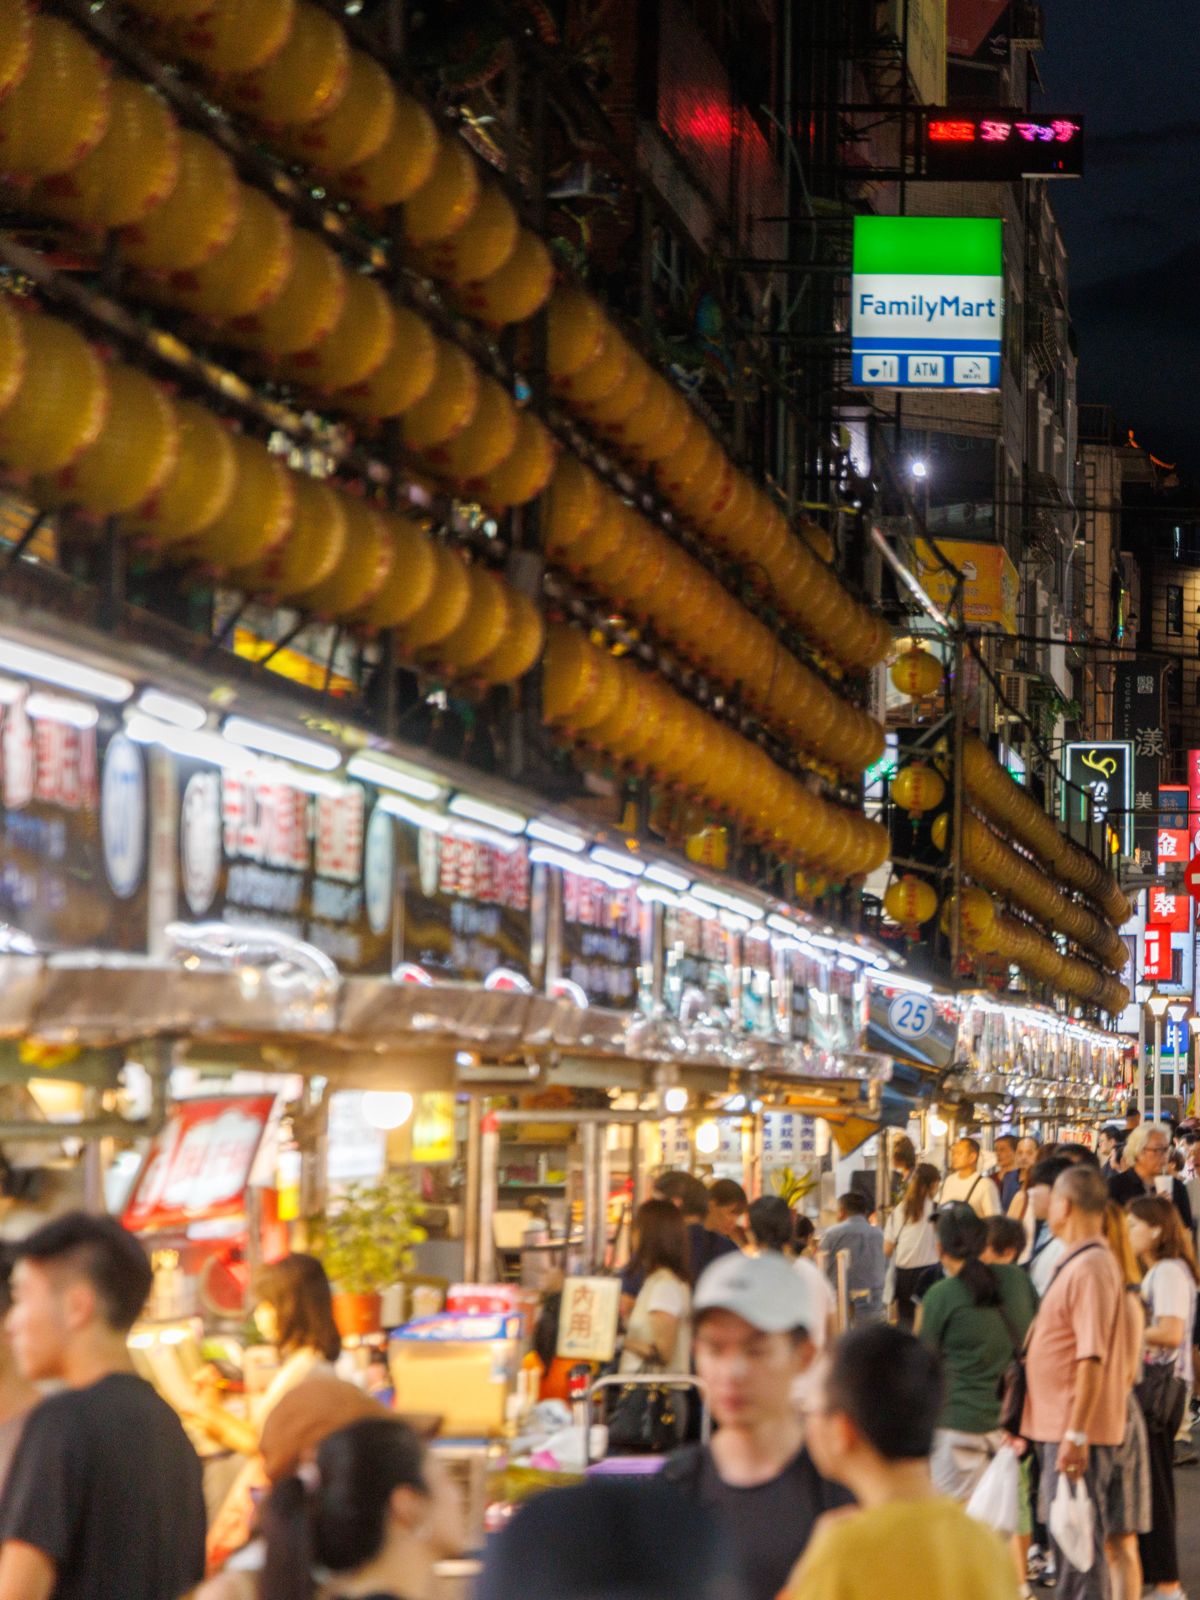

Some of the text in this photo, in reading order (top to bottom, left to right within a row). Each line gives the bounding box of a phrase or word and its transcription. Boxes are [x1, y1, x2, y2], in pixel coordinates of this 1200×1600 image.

[859, 294, 996, 321] FamilyMart
[913, 362, 938, 377] ATM
[896, 1000, 927, 1032] 25
